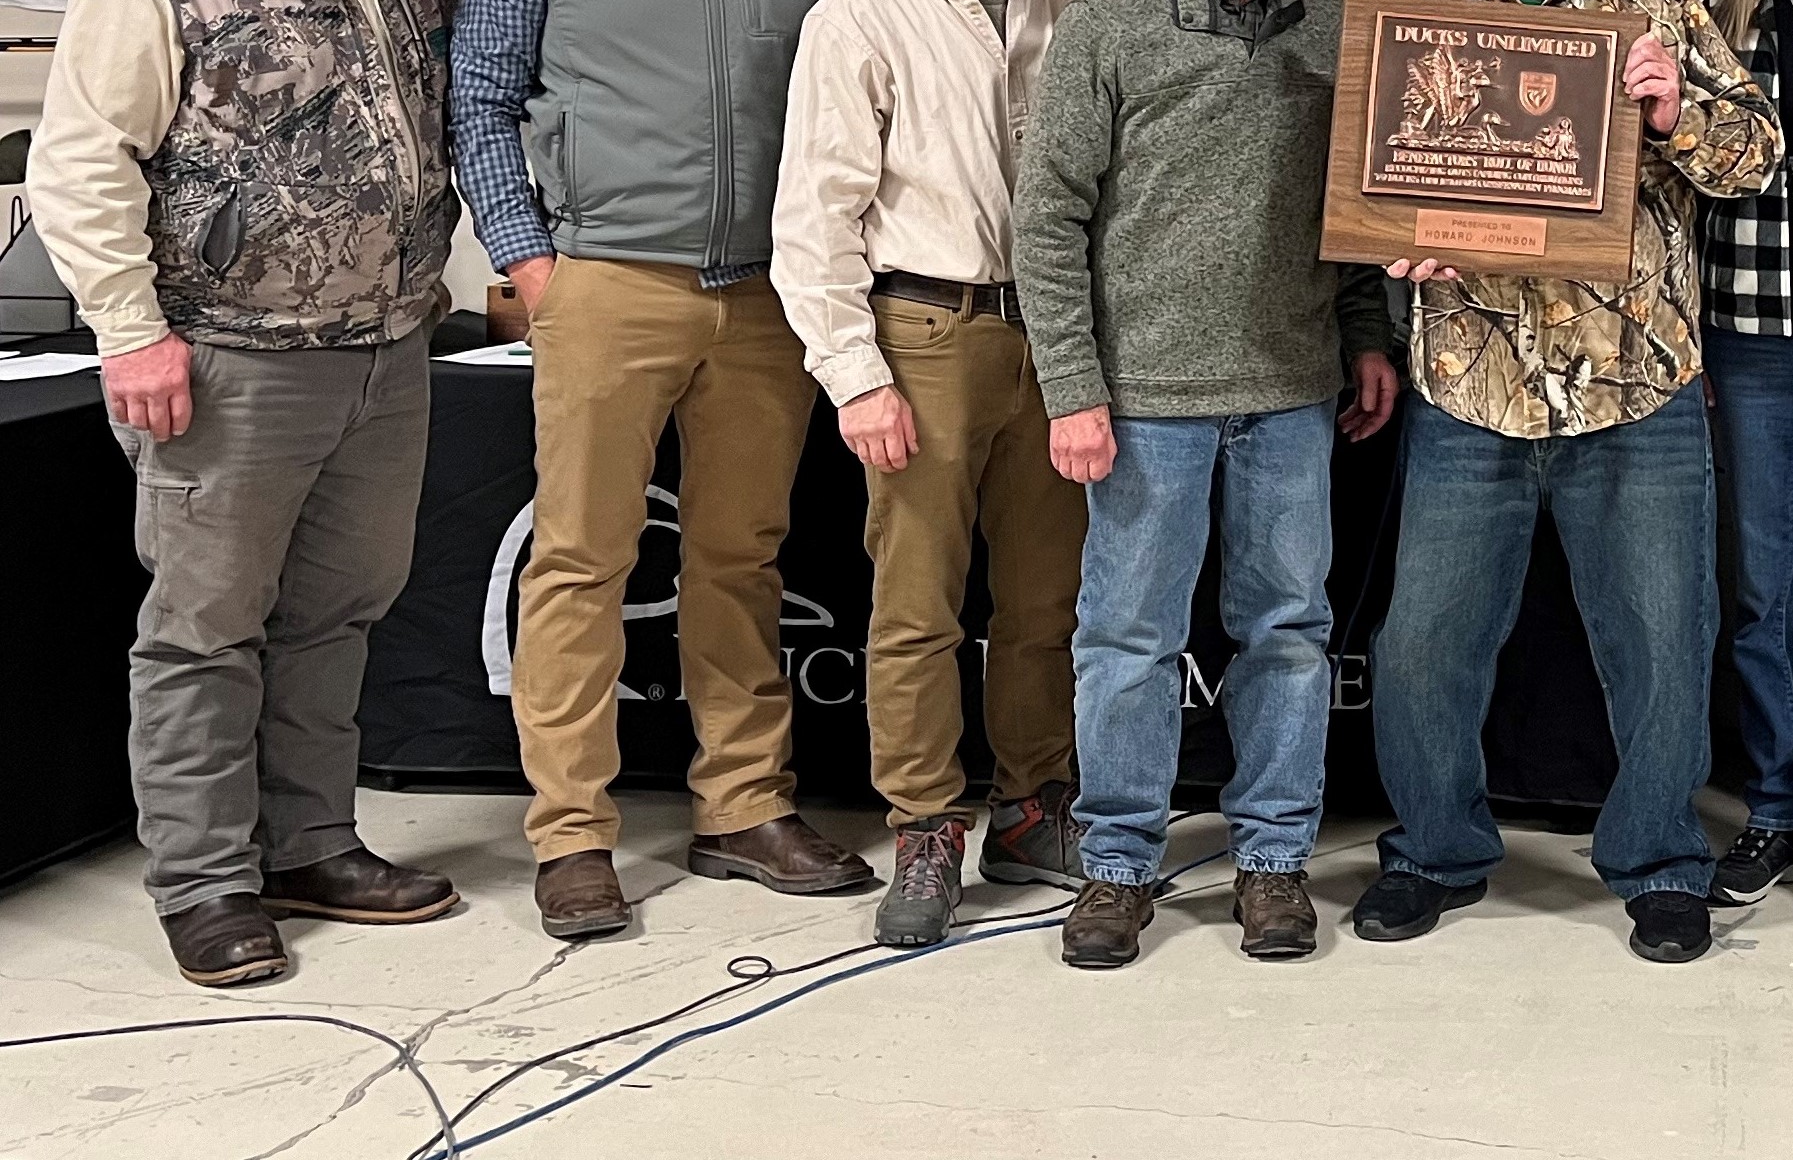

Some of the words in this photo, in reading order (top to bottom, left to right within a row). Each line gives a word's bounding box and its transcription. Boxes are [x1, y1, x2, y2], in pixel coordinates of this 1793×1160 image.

[1395, 25, 1468, 47] DUCKS
[1477, 32, 1597, 58] UNLIMITED
[1424, 229, 1473, 243] HOWARD
[1481, 234, 1537, 247] JOHNSON
